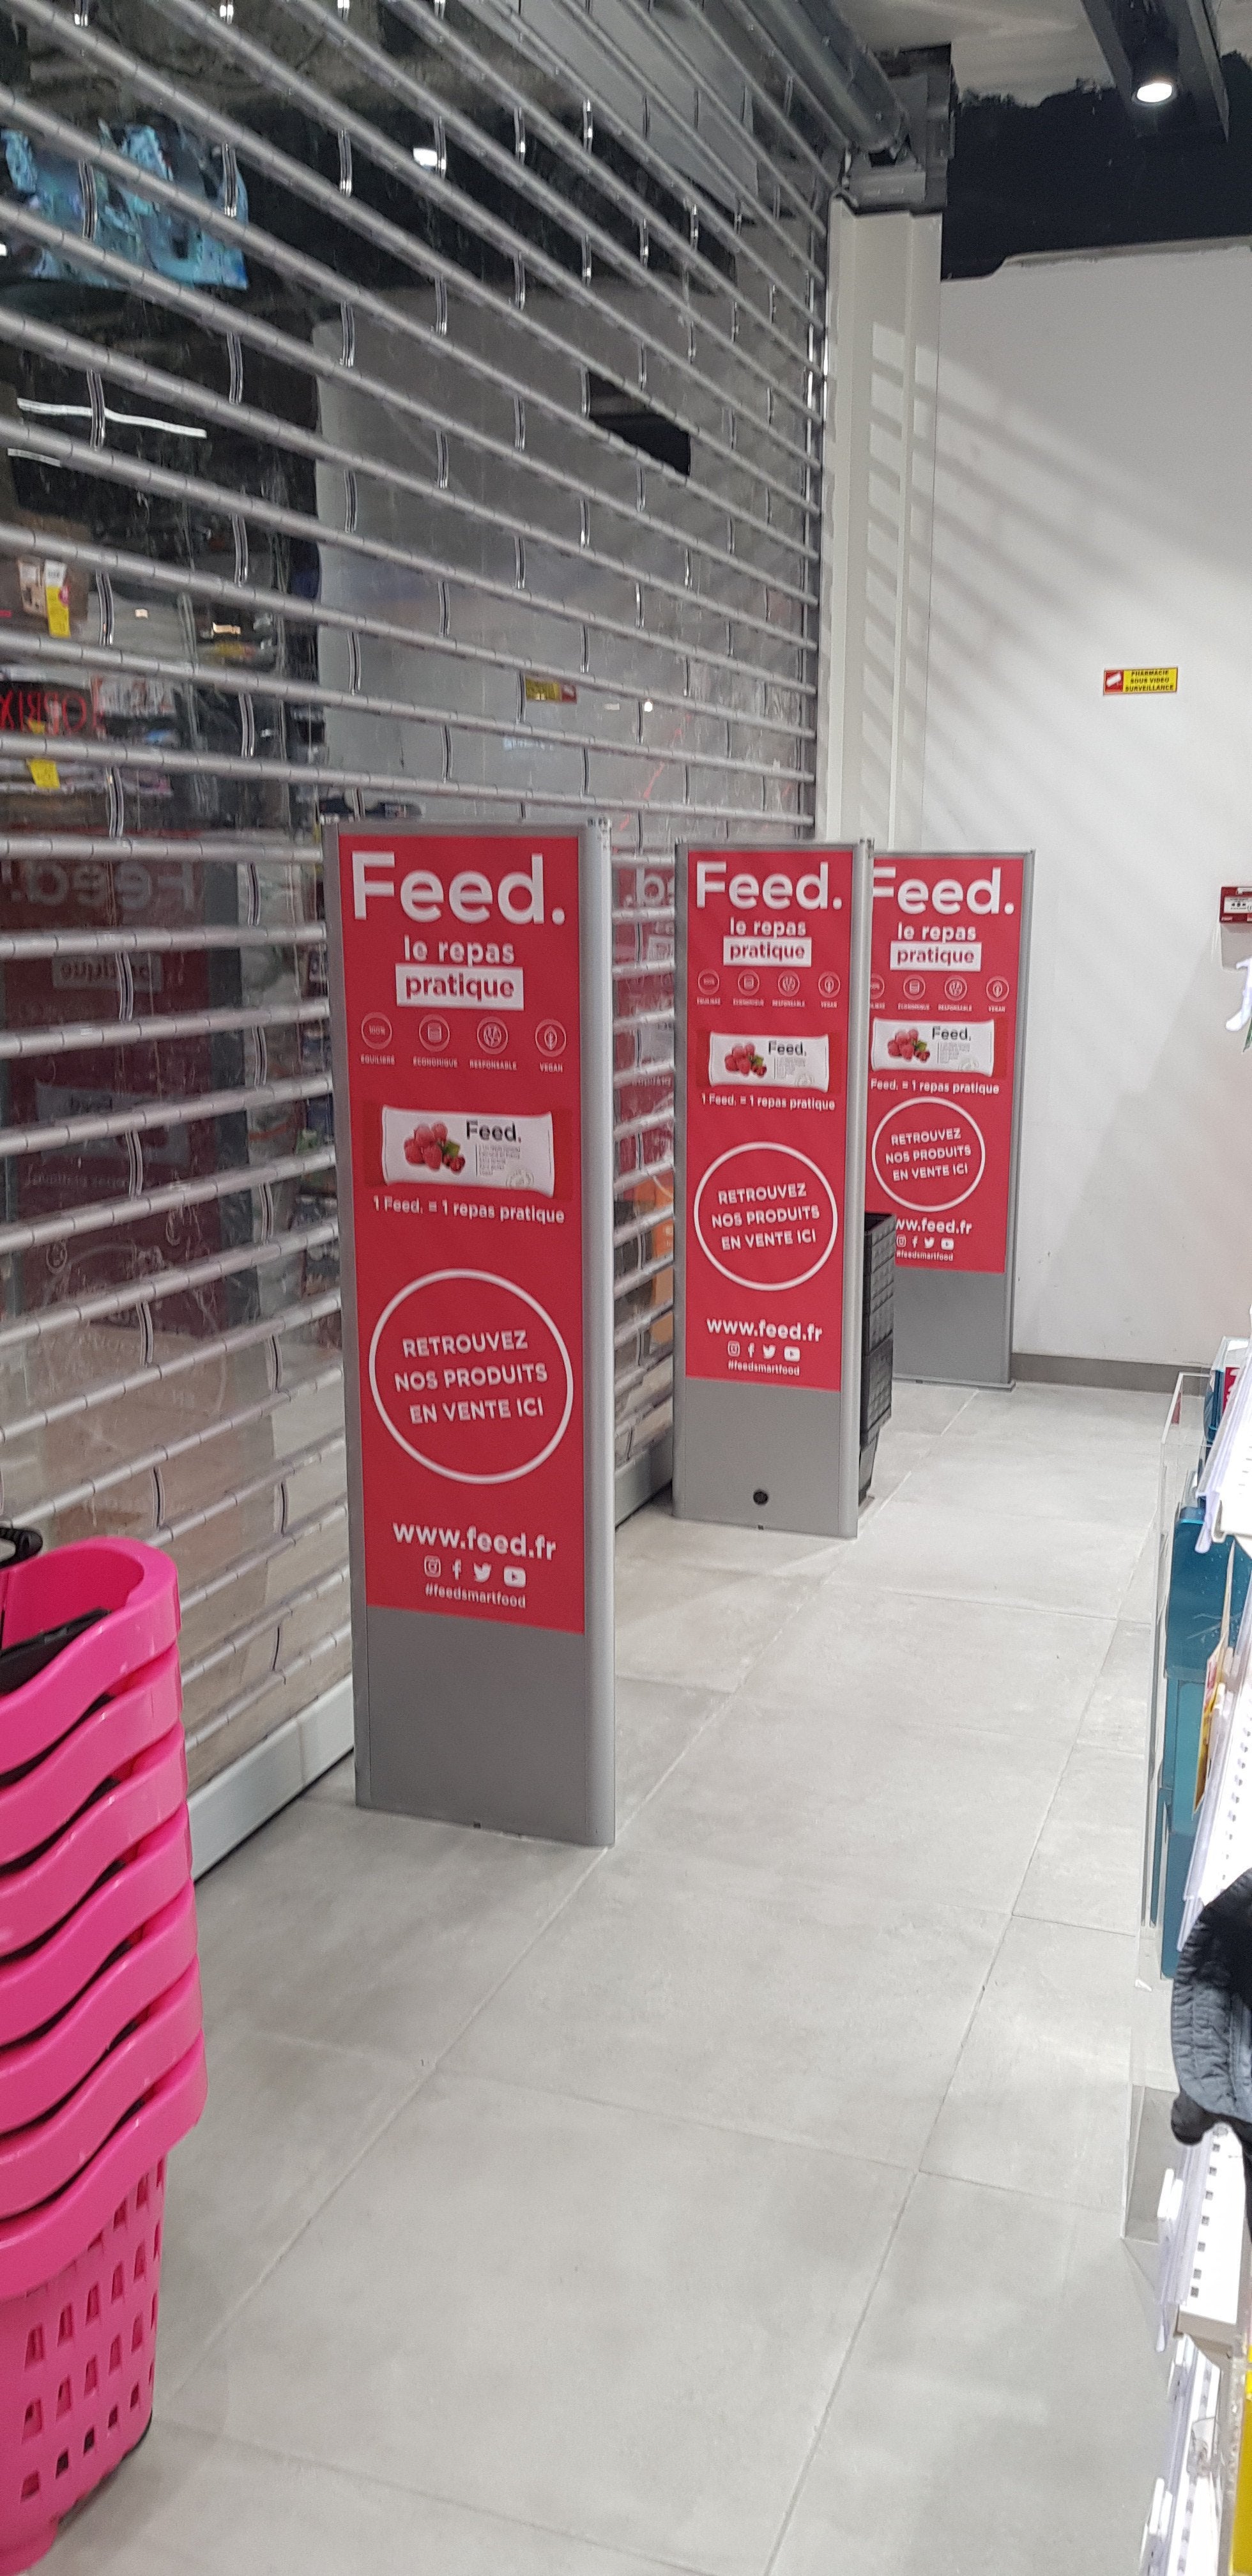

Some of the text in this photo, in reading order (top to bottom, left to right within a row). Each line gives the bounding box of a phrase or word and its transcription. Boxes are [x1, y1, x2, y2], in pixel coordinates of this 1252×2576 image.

[1125, 684, 1174, 693] SURVEILLANCE
[351, 850, 565, 925] Feed.
[696, 860, 843, 910] Feed.
[729, 916, 806, 940] le repas
[897, 921, 977, 944] le repas
[404, 935, 515, 967] le repas
[729, 941, 805, 962] pratique
[897, 946, 975, 967] pratique
[406, 972, 514, 1002] pratique
[932, 1025, 972, 1041] Feed.
[768, 1040, 807, 1057] Feed.
[539, 1062, 563, 1073] VEGAN
[871, 1077, 899, 1091] Feed.
[919, 1082, 950, 1094] repas
[952, 1082, 1000, 1096] pratique
[708, 1092, 737, 1106] Feed.
[757, 1096, 787, 1109] repas
[790, 1097, 836, 1112] pratique
[466, 1120, 522, 1144] Feed.
[890, 1127, 961, 1146] RETROUVEZ
[885, 1144, 972, 1165] NOS PRODUITS
[892, 1162, 968, 1182] EN VENTE ICI
[718, 1182, 807, 1205] RETROUVEZ
[384, 1195, 424, 1214] Feed.
[453, 1202, 495, 1220] repas
[500, 1205, 565, 1225] pratique
[712, 1204, 820, 1229] NOS PRODUITS
[895, 1216, 972, 1235] ww.feed.fr
[721, 1228, 816, 1251] EN VENTE ICI
[896, 1248, 954, 1262] #feedsmartfood
[706, 1318, 823, 1342] www.feed.fr
[402, 1330, 528, 1358] RETROUVEZ
[394, 1362, 548, 1392] NOS PRODUITS
[728, 1359, 800, 1376] #feedsmartfood
[409, 1397, 544, 1424] EN VENTE ICI
[392, 1522, 556, 1561] www.feed.fr
[425, 1581, 526, 1609] #feedsmartfood
